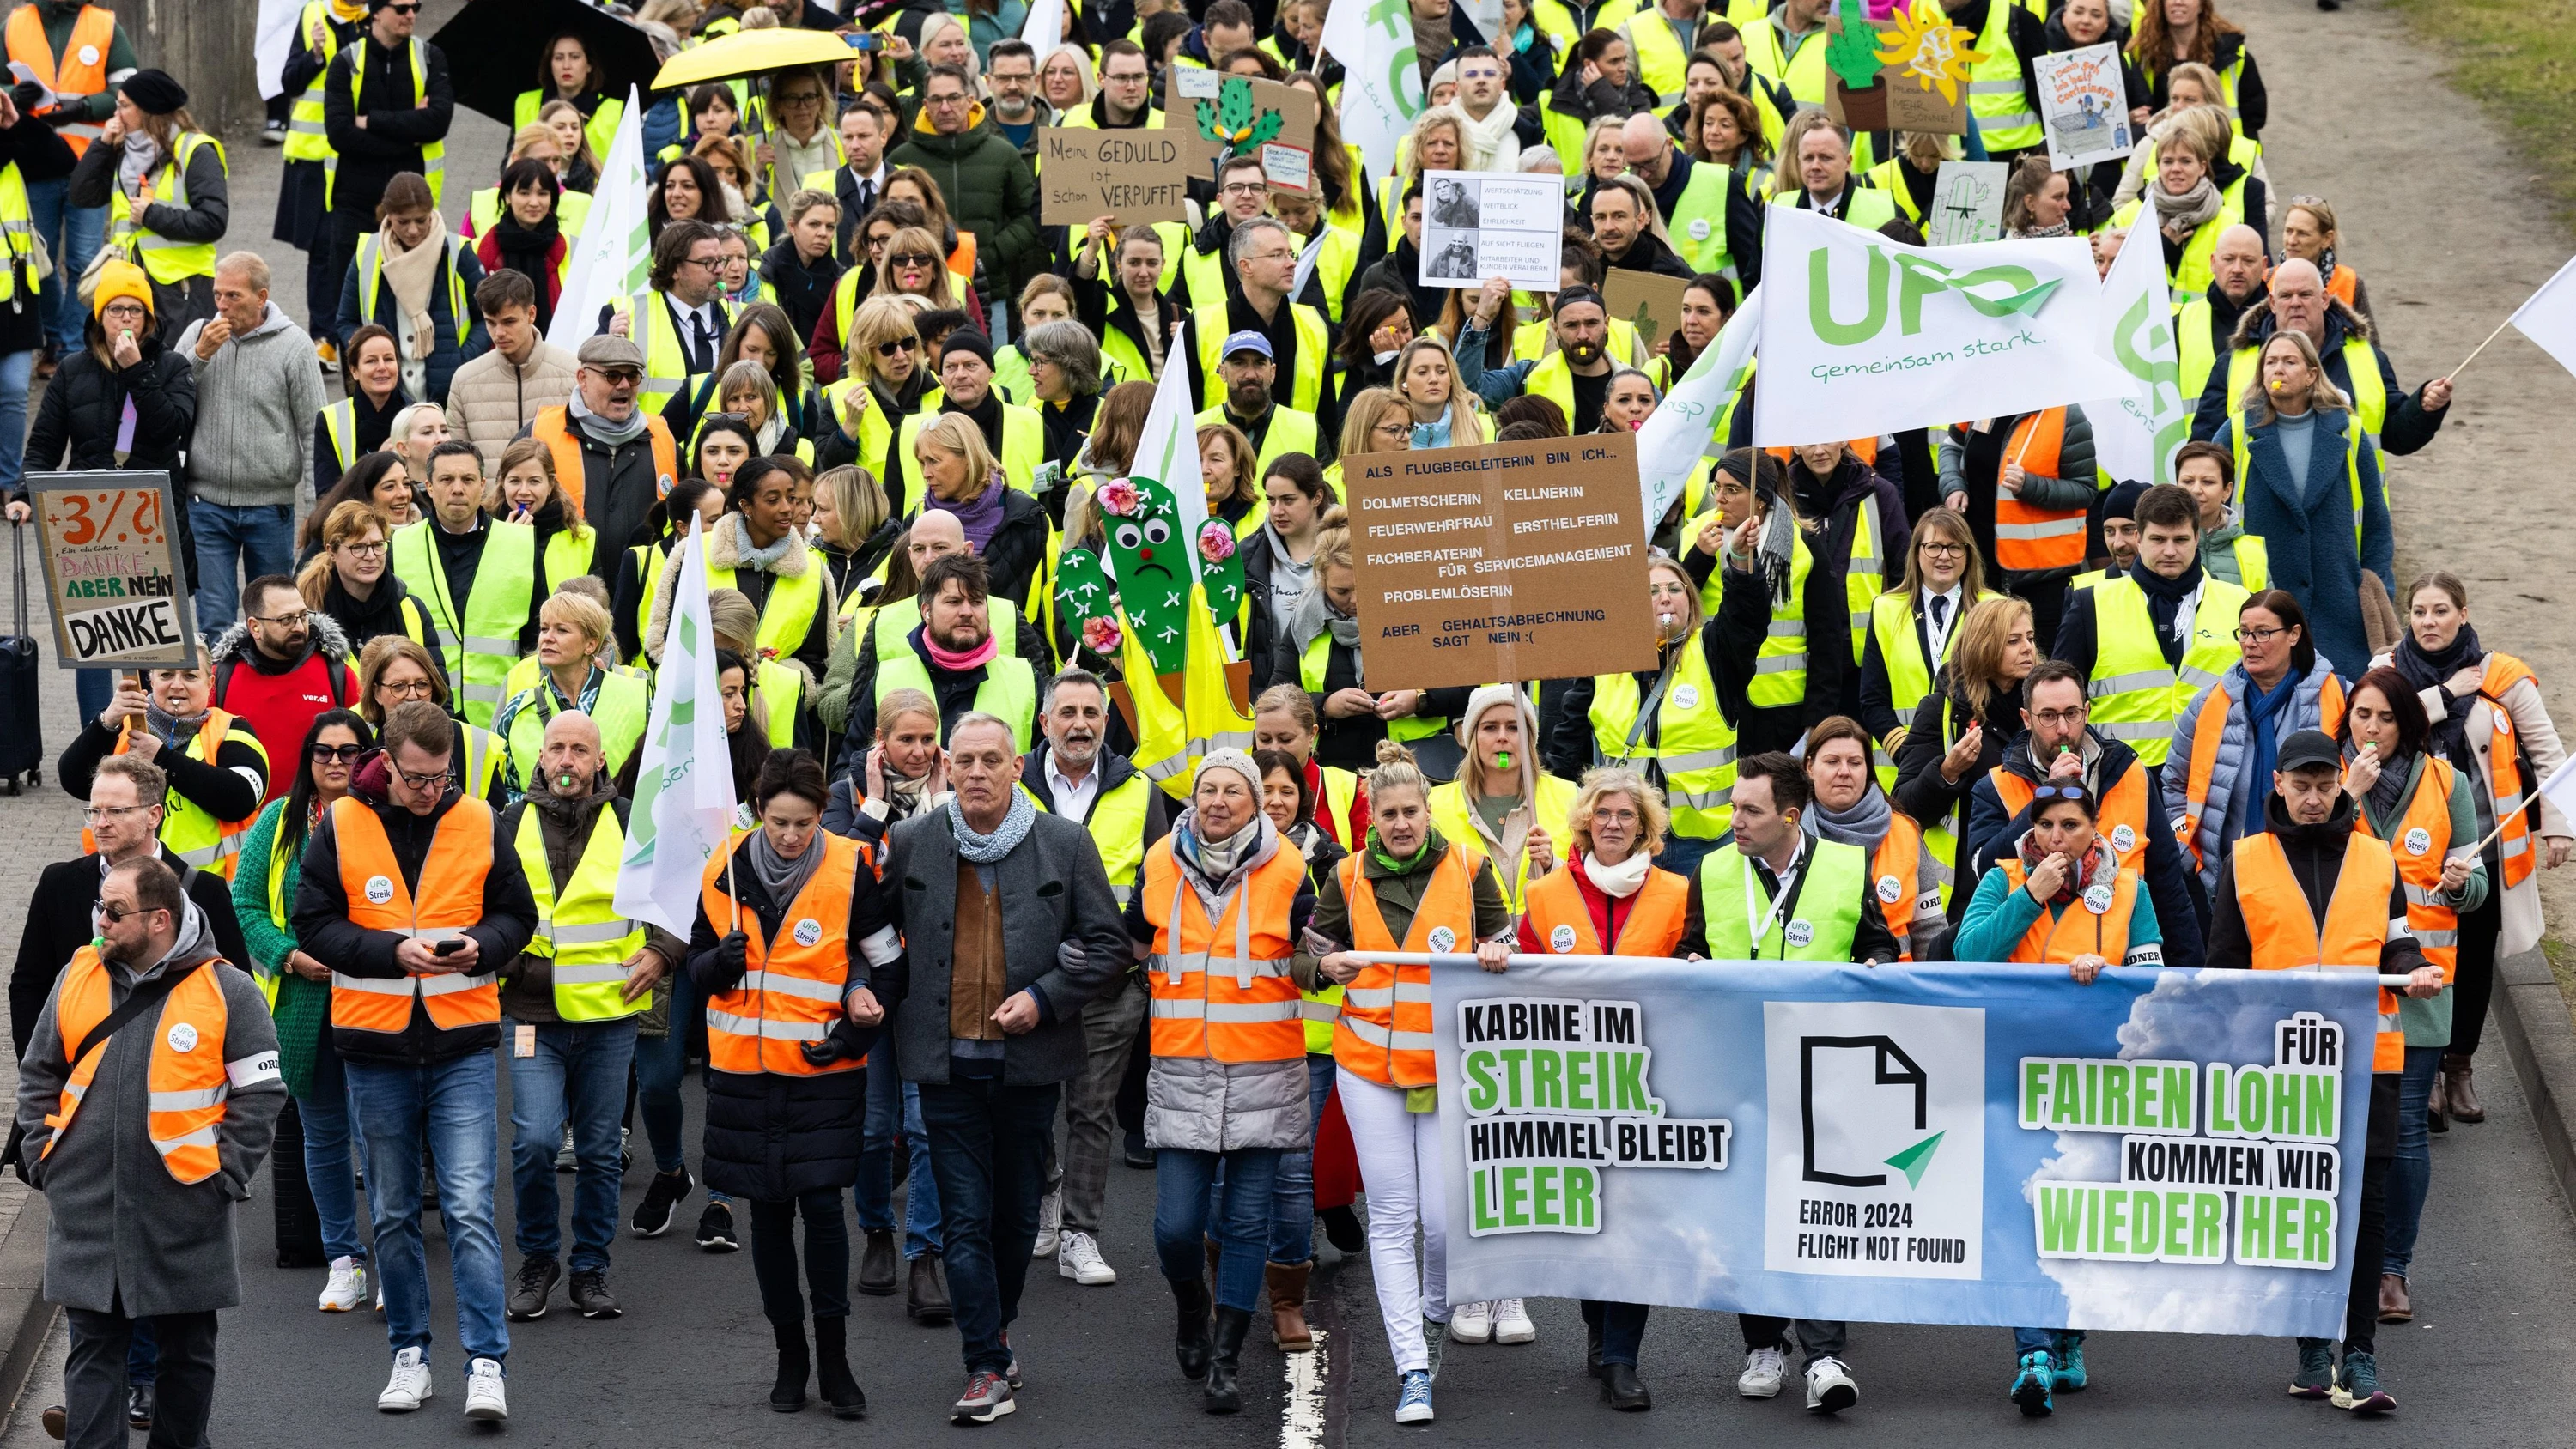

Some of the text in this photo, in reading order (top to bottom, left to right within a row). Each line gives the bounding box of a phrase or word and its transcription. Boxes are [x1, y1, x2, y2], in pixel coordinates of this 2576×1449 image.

[1050, 137, 1176, 164] Meine GEDULD
[1091, 167, 1111, 183] ist
[1101, 184, 1182, 208] VERPUFFT
[1484, 187, 1543, 196] WERTSCHÄTZUNG
[1808, 245, 2063, 346] UFO
[1811, 351, 1953, 384] Gemeinsam
[1365, 448, 1617, 479] ALS FLUGBEGLEITERIN BIN ICH...
[1362, 487, 1583, 510] DOLMETSCHERIN KELLNERIN
[1368, 512, 1619, 538] FEUERWEHRFRAU ERSTHELFERIN
[1367, 546, 1483, 566] FACHBERATERIN
[1438, 544, 1632, 578] FÜR SERVICEMANAGEMENT
[66, 574, 174, 597] ABER NEIN
[1384, 585, 1513, 603] PROBLEMLÖSERIN
[69, 601, 180, 658] DANKE
[1382, 609, 1606, 638] ABER GEHALTSABRECHNUNG
[1432, 634, 1470, 648] SAGT
[1488, 631, 1521, 644] NEIN
[302, 694, 328, 703] ver.di
[1674, 695, 1695, 705] Streik
[2117, 827, 2133, 836] UFO
[2411, 831, 2428, 840] UFO
[2114, 838, 2132, 848] Streik
[2408, 840, 2427, 852] Streik
[370, 879, 388, 888] UFO
[1884, 877, 1899, 889] UFO
[369, 890, 391, 899] Streik
[1879, 885, 1897, 900] Streik
[2092, 888, 2110, 900] UFO
[2086, 896, 2106, 911] Streik
[803, 920, 821, 933] UFO
[1554, 927, 1571, 937] UFO
[1791, 921, 1810, 931] UFO
[795, 930, 816, 944] Streik
[1440, 928, 1455, 943] UFO
[1553, 937, 1573, 949] Streik
[1788, 932, 1809, 943] Streik
[177, 1025, 196, 1038] UFO
[1465, 1003, 1635, 1044] KABINE IM
[170, 1034, 191, 1050] Streik
[2281, 1018, 2337, 1066] FÜR
[1467, 1049, 1658, 1116] STREIK,
[2025, 1063, 2335, 1137] FAIREN LOHN
[1470, 1121, 1725, 1163] HIMMEL BLEIBT
[2128, 1142, 2334, 1191] KOMMEN WIR
[1473, 1166, 1594, 1231] LEER
[1799, 1199, 1913, 1228] ERROR 2024
[2040, 1187, 2331, 1264] WIEDER HER
[1797, 1233, 1965, 1264] FLIGHT NOT FOUND
